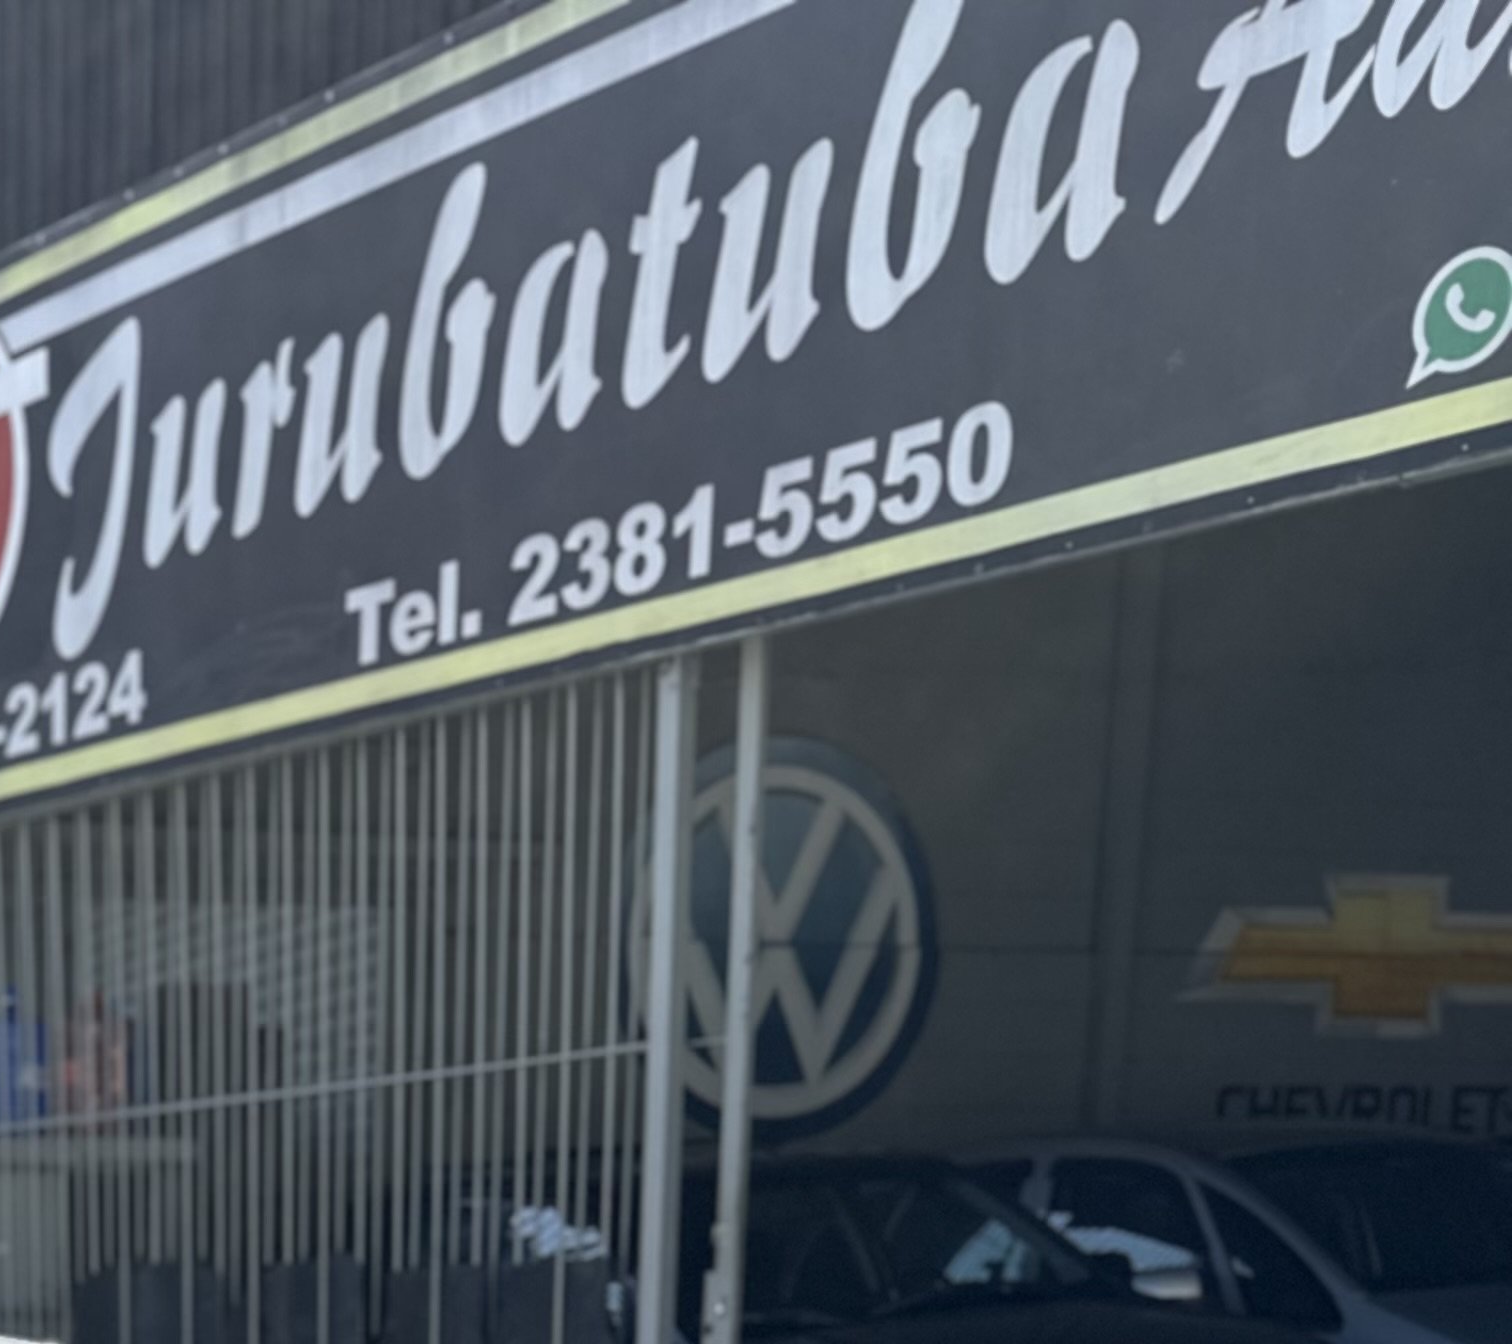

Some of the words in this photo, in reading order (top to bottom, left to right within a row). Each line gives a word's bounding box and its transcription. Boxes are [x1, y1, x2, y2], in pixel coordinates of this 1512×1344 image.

[48, 0, 1140, 661] Jurubatuba
[344, 559, 482, 666] Tel.
[507, 400, 1013, 627] 2381-5550
